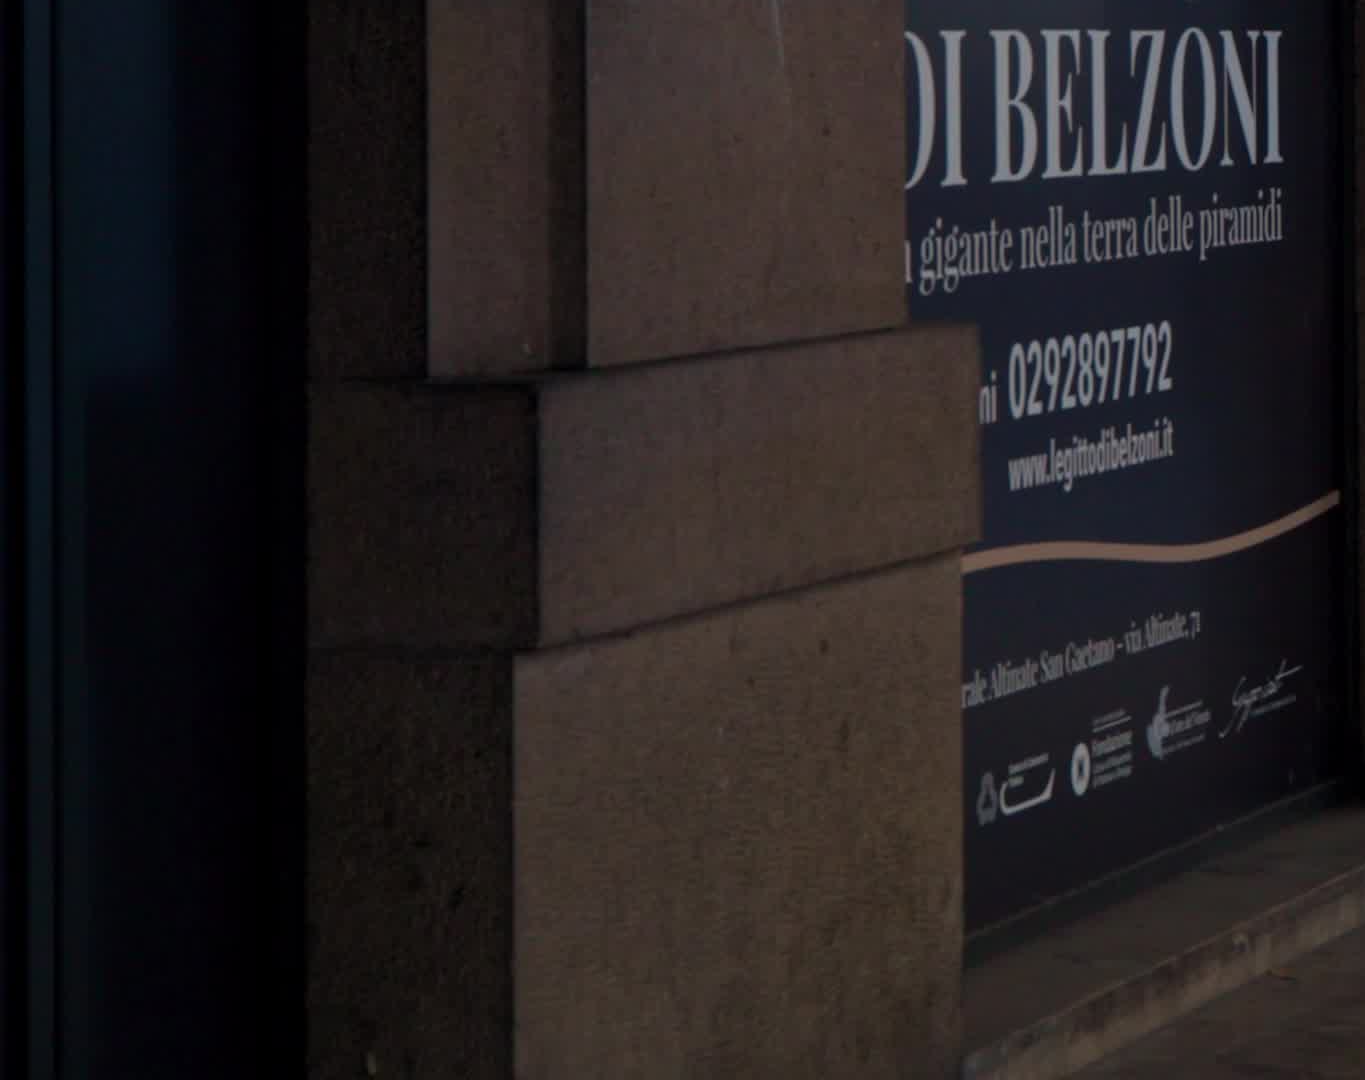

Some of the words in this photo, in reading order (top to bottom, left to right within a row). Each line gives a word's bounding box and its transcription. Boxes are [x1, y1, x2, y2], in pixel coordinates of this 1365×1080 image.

[990, 26, 1284, 184] BELZONI
[919, 217, 1014, 297] gigante
[1019, 204, 1078, 270] nella
[1082, 209, 1138, 262] terra
[1143, 195, 1194, 256] delle
[1199, 186, 1283, 262] piramidi
[1008, 320, 1173, 420] 0292897792
[1008, 415, 1174, 493] www.legittodibelzoni.it
[1039, 649, 1065, 685] San
[1064, 636, 1116, 676] Gaetano
